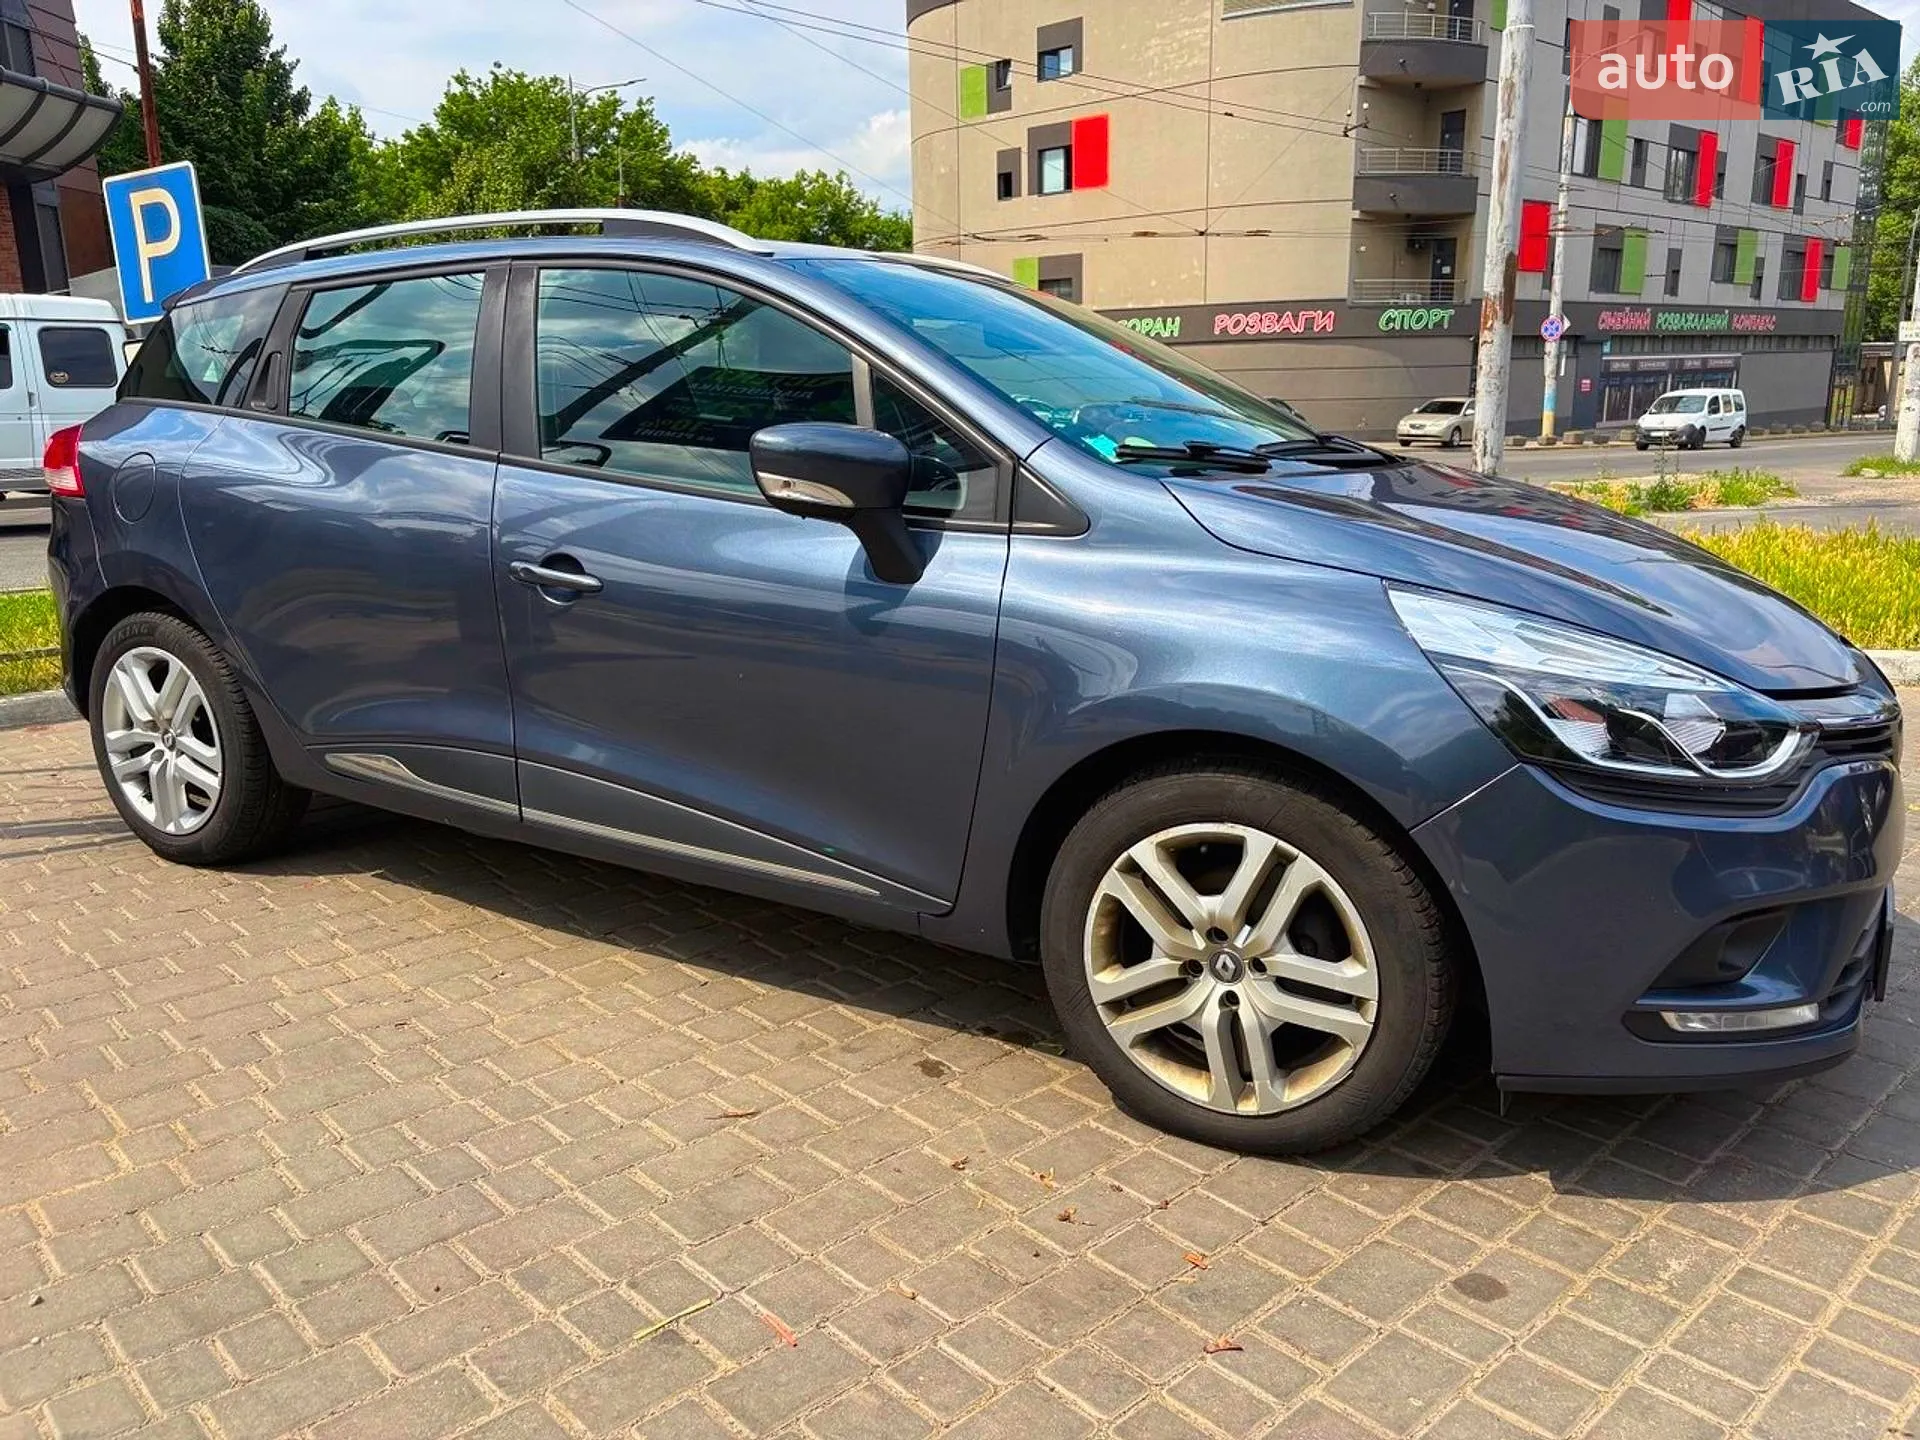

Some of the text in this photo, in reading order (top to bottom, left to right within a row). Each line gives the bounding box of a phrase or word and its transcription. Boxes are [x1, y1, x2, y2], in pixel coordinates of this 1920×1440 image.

[129, 187, 181, 304] P
[1213, 310, 1335, 335] РОЗВАГИ
[1378, 308, 1455, 332] СПОРТ
